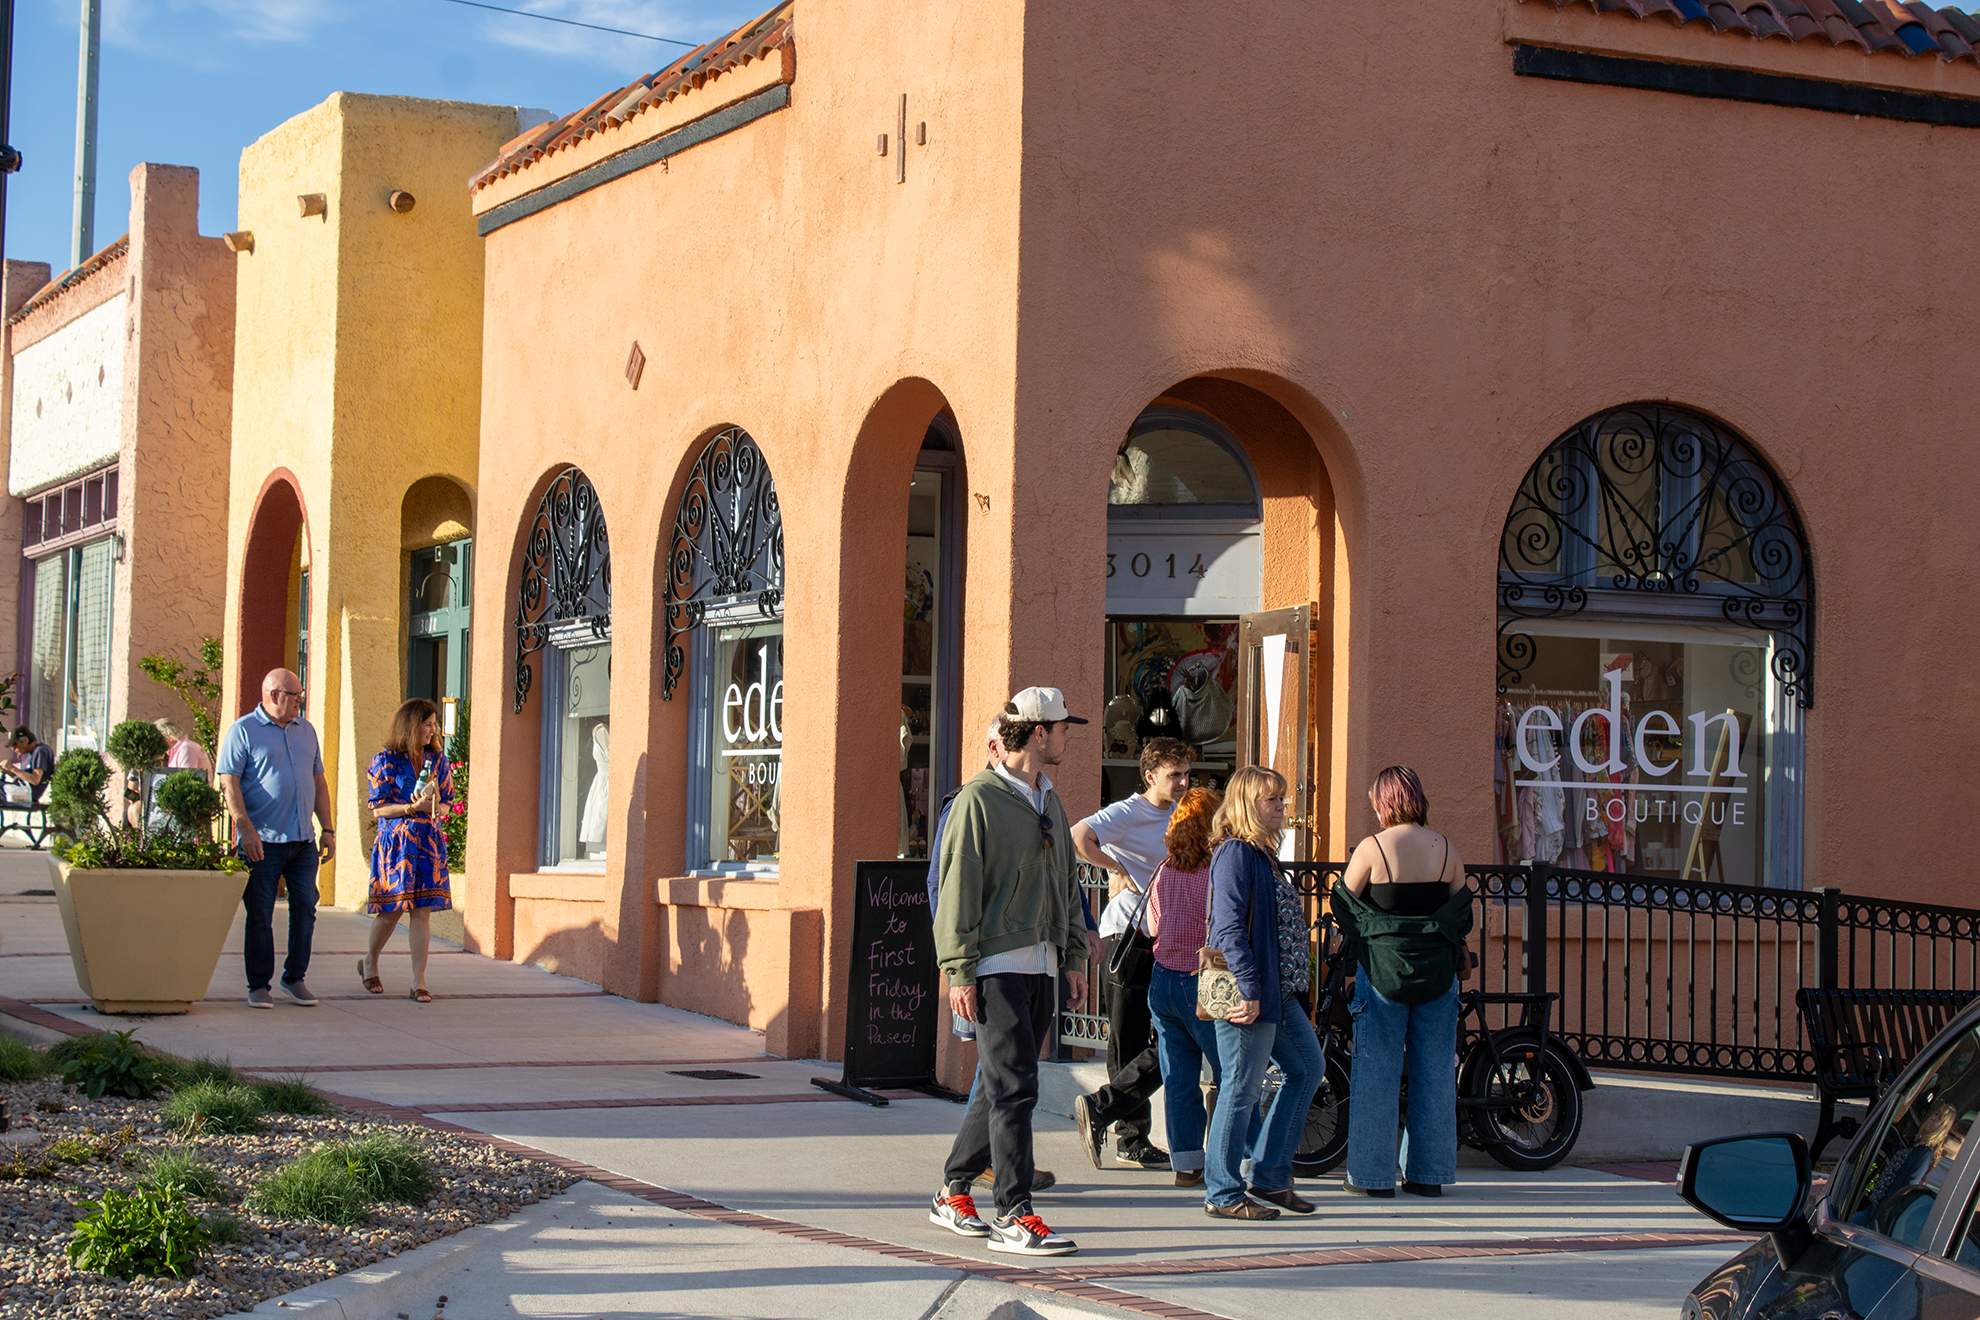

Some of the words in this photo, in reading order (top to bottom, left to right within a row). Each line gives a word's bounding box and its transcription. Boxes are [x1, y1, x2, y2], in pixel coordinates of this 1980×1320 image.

[1106, 552, 1208, 579] 3014
[1516, 668, 1747, 777] eden
[1586, 798, 1745, 825] BOUTIQUE
[868, 876, 928, 909] Welcome
[884, 912, 907, 934] to
[868, 941, 915, 969] First
[868, 973, 926, 1010] Friday
[869, 1003, 884, 1021] in
[890, 1003, 914, 1021] the
[866, 1024, 918, 1048] Paseo!
